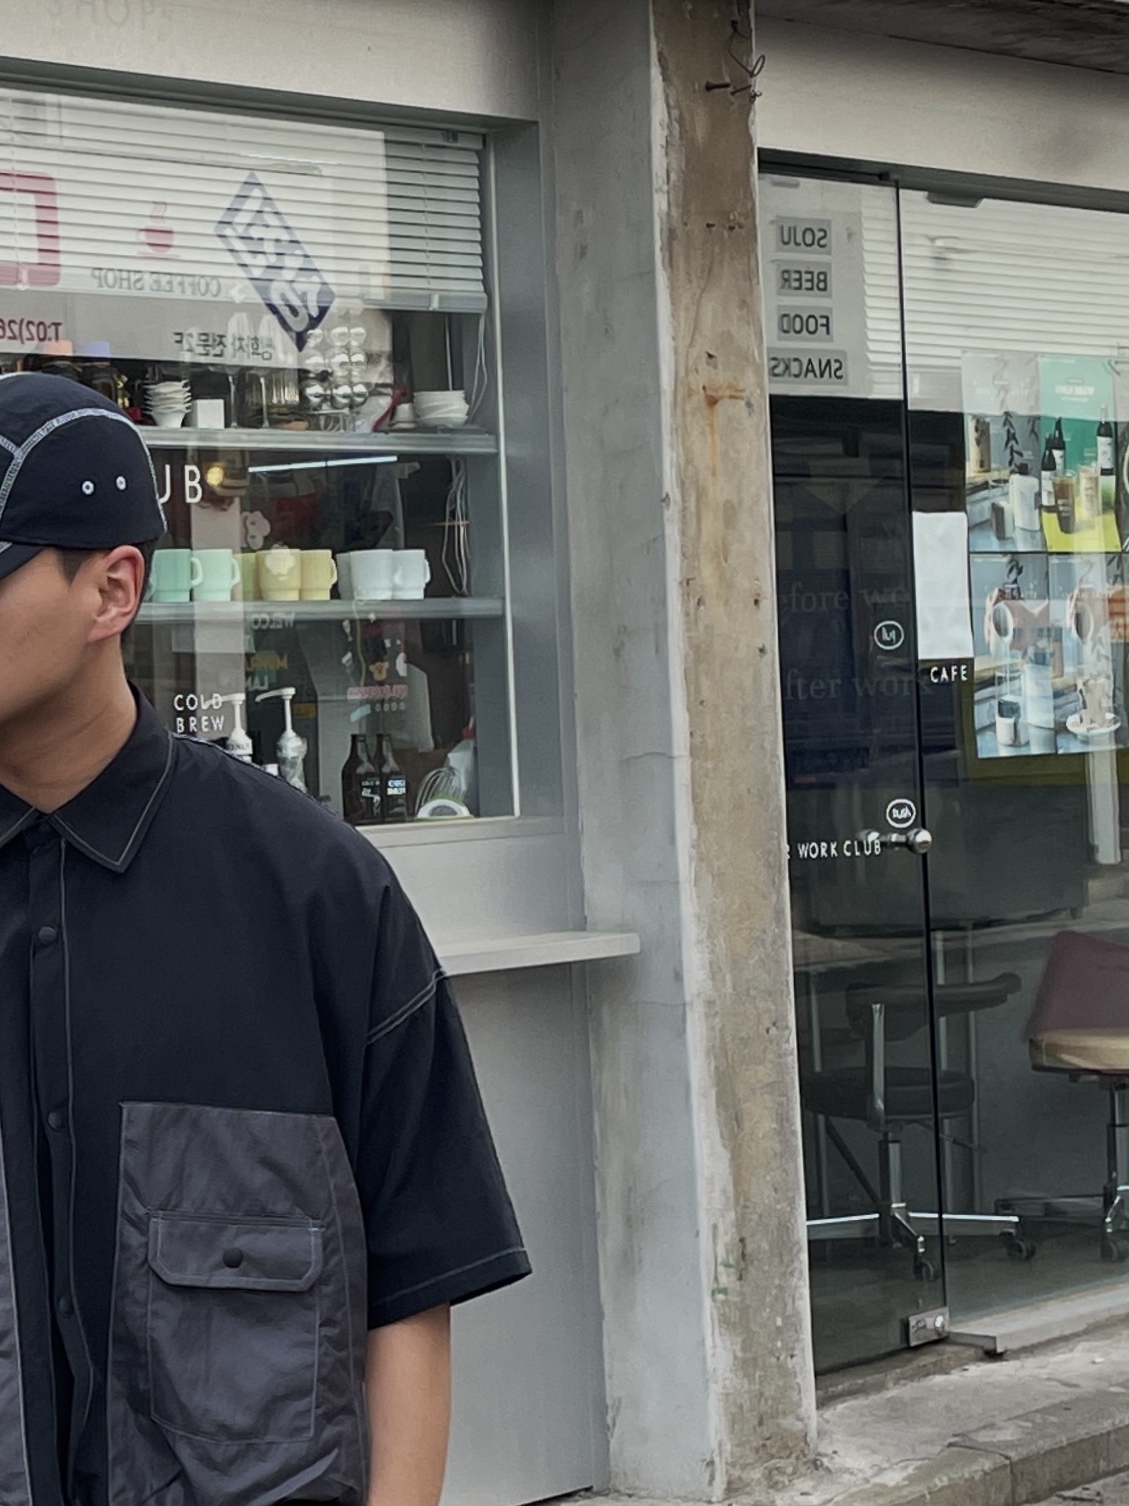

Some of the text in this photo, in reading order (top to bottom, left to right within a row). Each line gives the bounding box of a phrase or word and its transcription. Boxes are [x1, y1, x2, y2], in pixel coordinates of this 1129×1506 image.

[930, 665, 969, 683] CAFE
[173, 693, 223, 711] COLD
[176, 715, 225, 732] BREW
[797, 839, 881, 859] WORK CLUB
